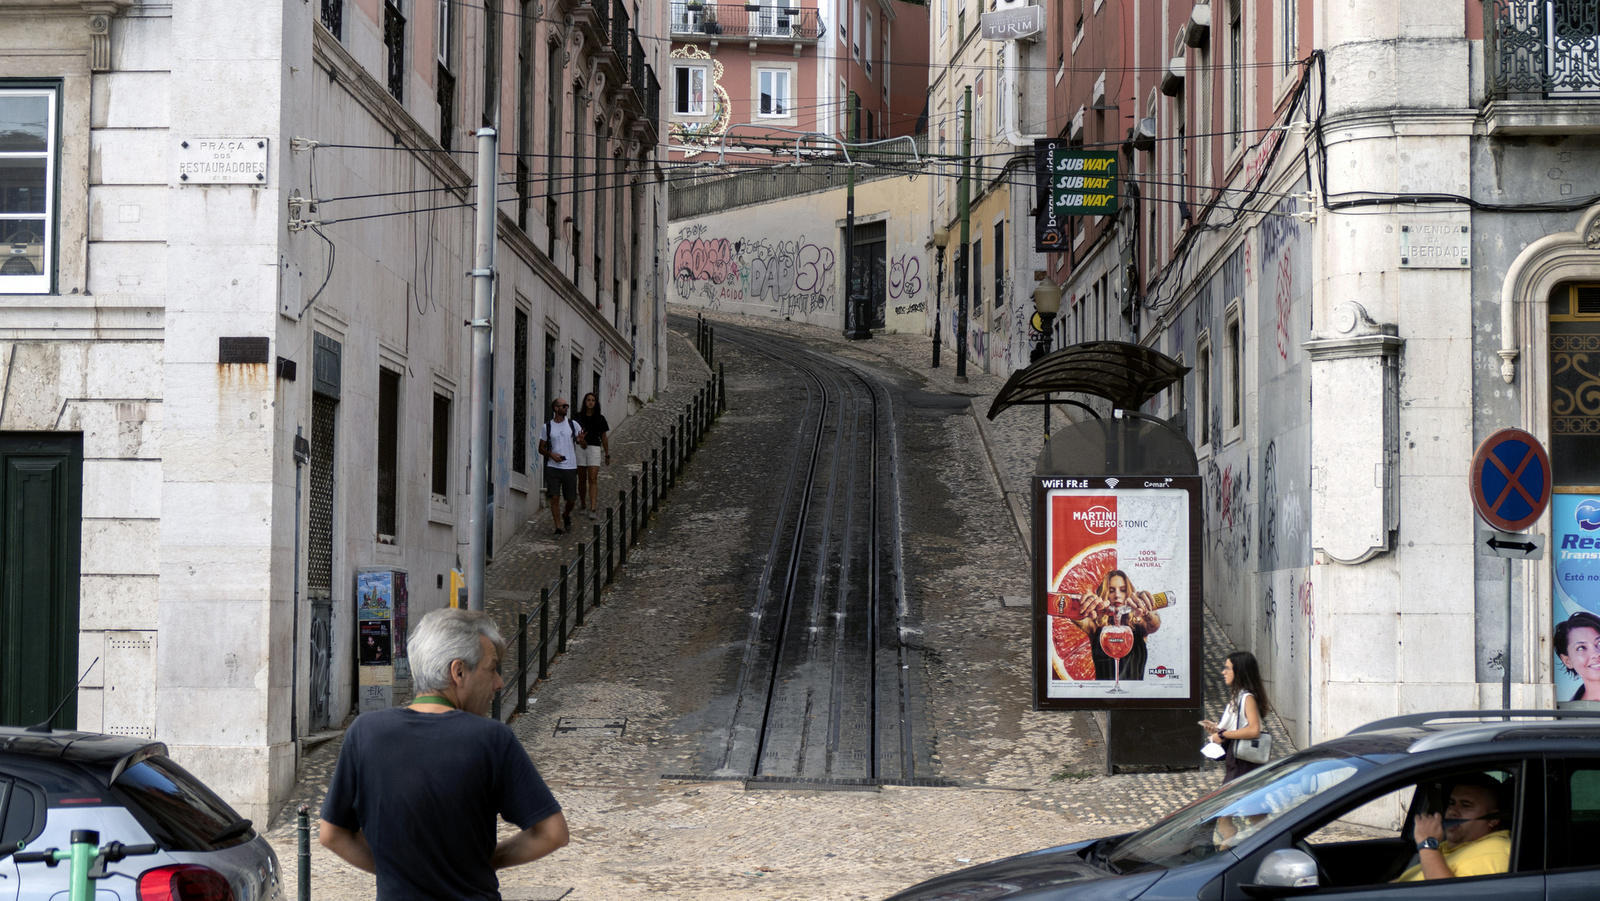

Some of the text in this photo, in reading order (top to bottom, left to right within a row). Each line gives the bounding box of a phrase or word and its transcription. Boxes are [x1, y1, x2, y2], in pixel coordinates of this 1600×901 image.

[990, 21, 1032, 34] TURIM
[200, 141, 245, 153] PRAÇA
[180, 162, 265, 173] RESTAURADORES
[1056, 158, 1115, 171] SUBWAY
[1056, 176, 1115, 189] SUBWAY
[1056, 194, 1115, 207] SUBWAY
[1408, 225, 1460, 234] AVENIDA
[1399, 245, 1469, 257] LIBERDADE
[1042, 479, 1064, 488] WiFi
[1073, 512, 1116, 520] MARTINI
[1090, 520, 1148, 528] FIERO & TONIC
[1561, 550, 1600, 559] Trans
[1565, 572, 1585, 581] Está
